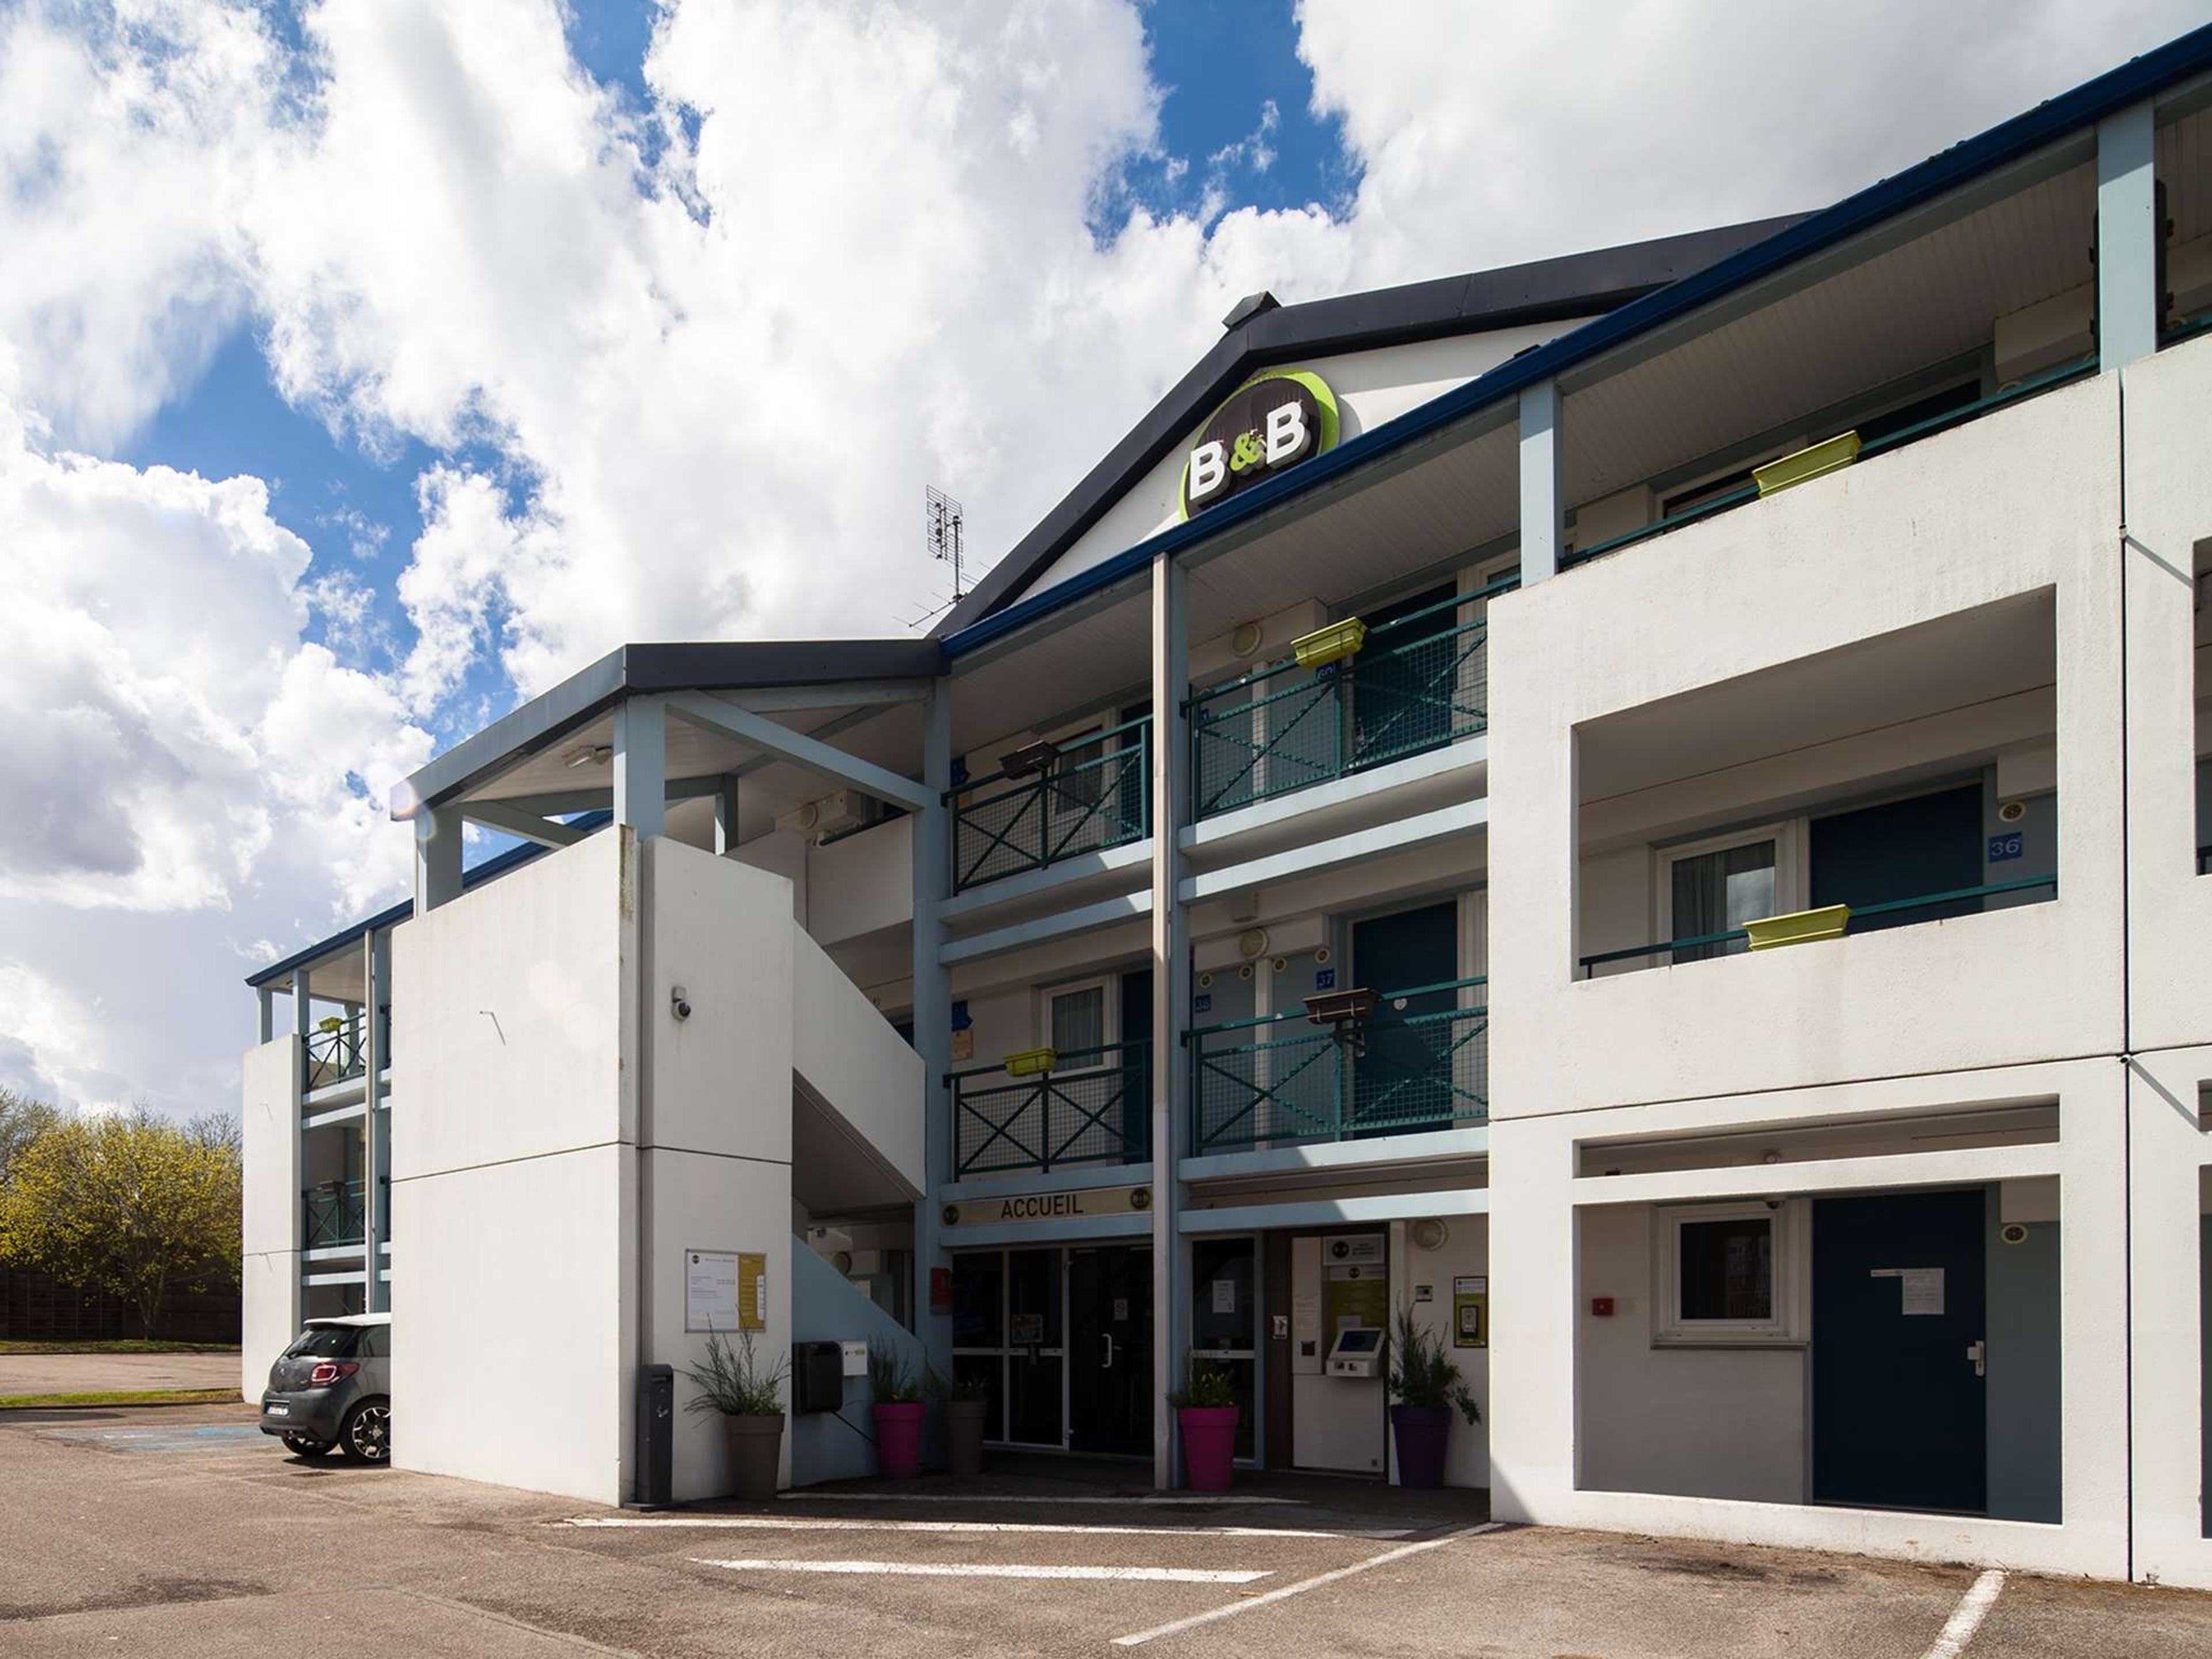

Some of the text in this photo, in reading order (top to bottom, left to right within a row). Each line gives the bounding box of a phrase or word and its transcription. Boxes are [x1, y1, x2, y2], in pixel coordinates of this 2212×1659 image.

[1190, 402, 1306, 500] B&B
[1991, 839, 2019, 856] 36
[1319, 974, 1332, 986] 37
[1001, 1194, 1084, 1218] ACCUEIL
